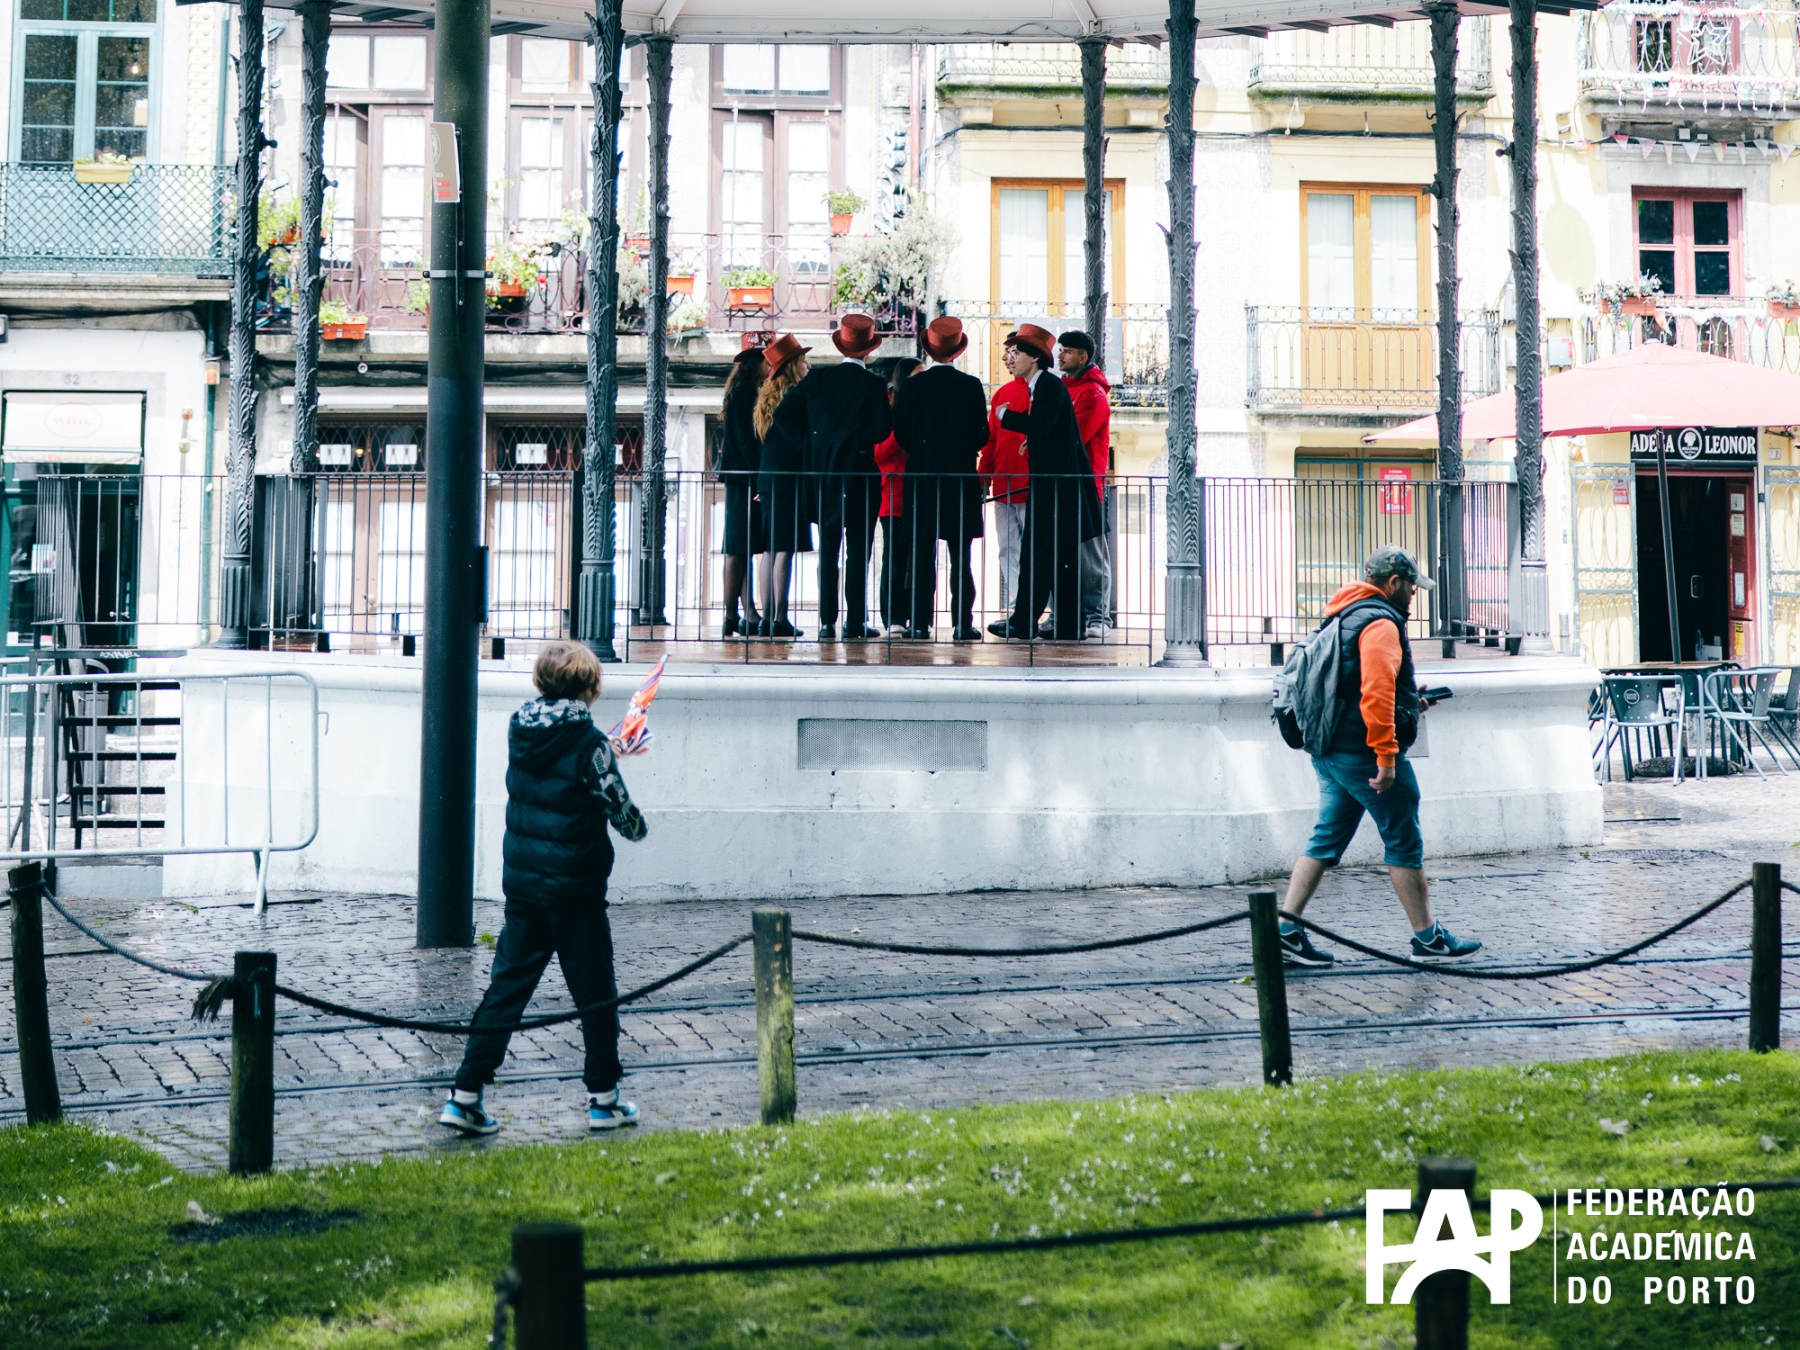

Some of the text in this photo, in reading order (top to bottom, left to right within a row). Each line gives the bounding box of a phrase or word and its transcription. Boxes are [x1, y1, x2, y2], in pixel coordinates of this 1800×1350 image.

[64, 373, 80, 385] 52
[1631, 433, 1675, 453] ADEA
[1704, 435, 1757, 455] LEONOR
